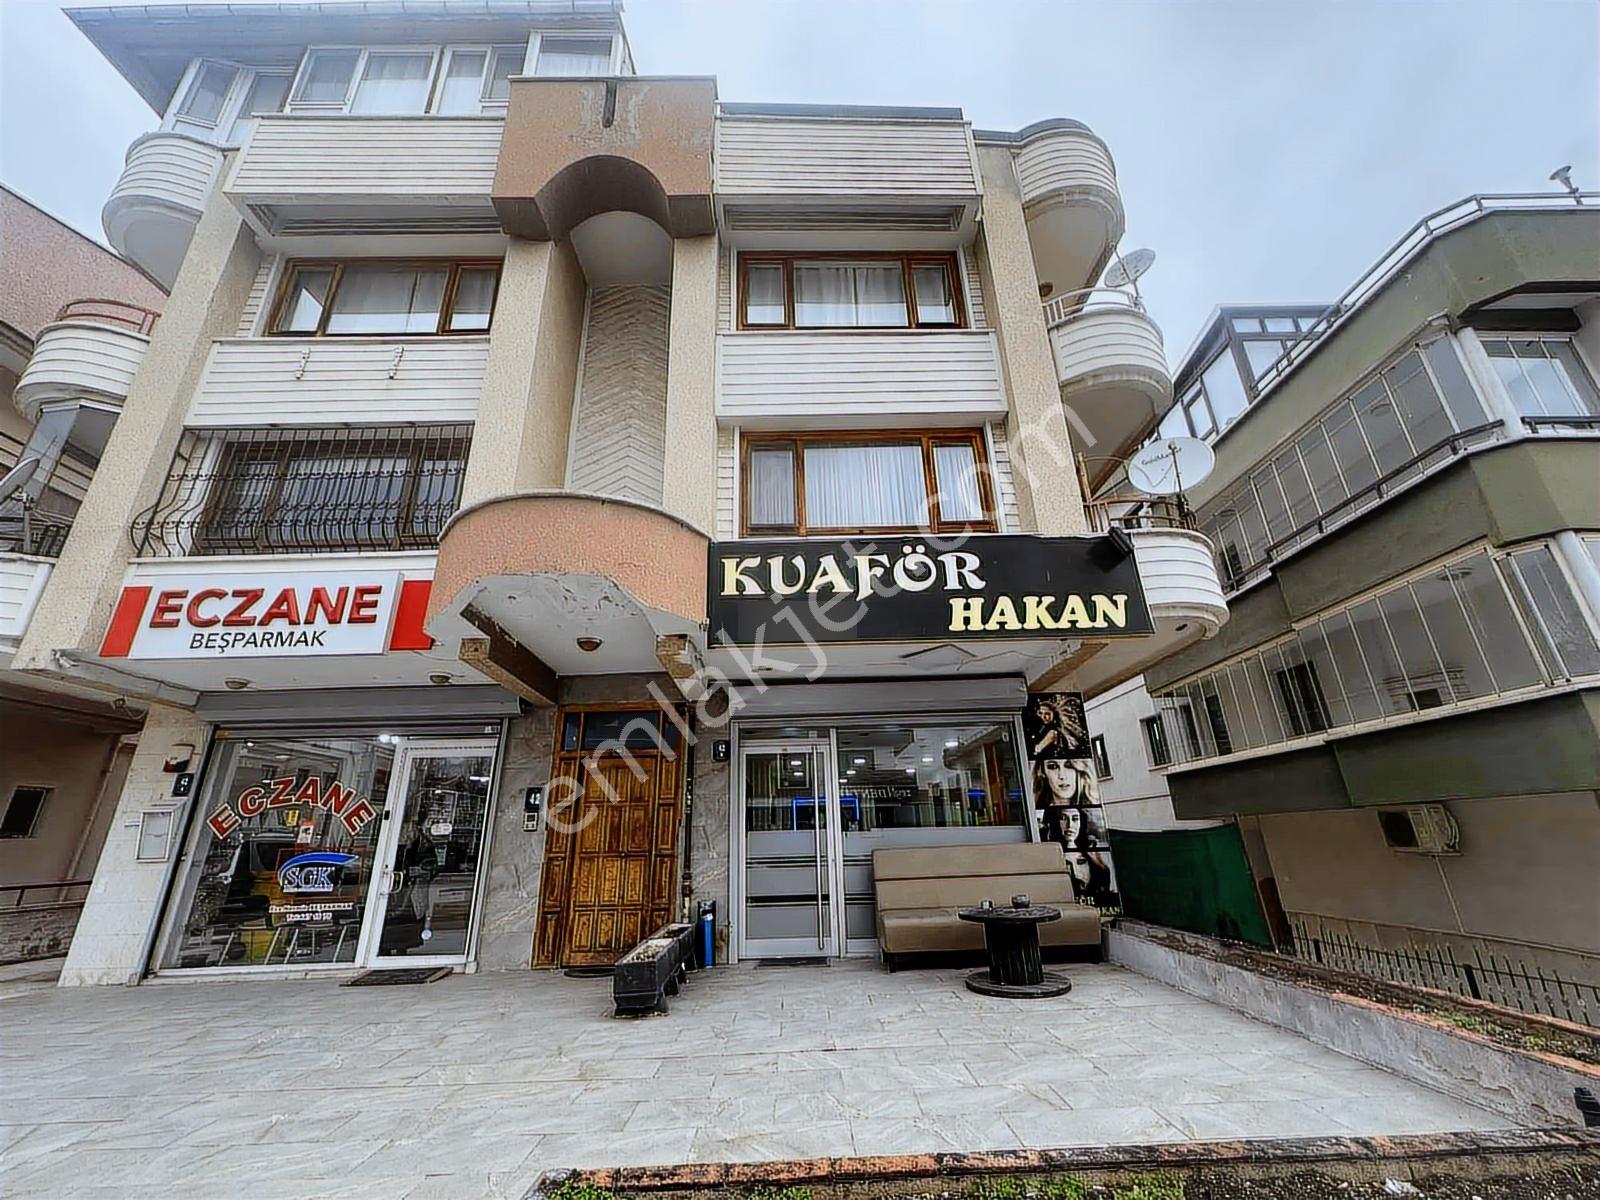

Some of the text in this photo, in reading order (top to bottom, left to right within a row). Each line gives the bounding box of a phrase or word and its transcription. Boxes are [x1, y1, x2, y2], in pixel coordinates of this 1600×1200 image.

[720, 545, 987, 601] KUAFÖR
[149, 585, 382, 628] ECZANE
[948, 594, 1128, 631] HAKAN
[189, 630, 327, 654] BEŞPARMAK
[207, 776, 377, 839] ECZANE
[284, 867, 336, 887] SGK
